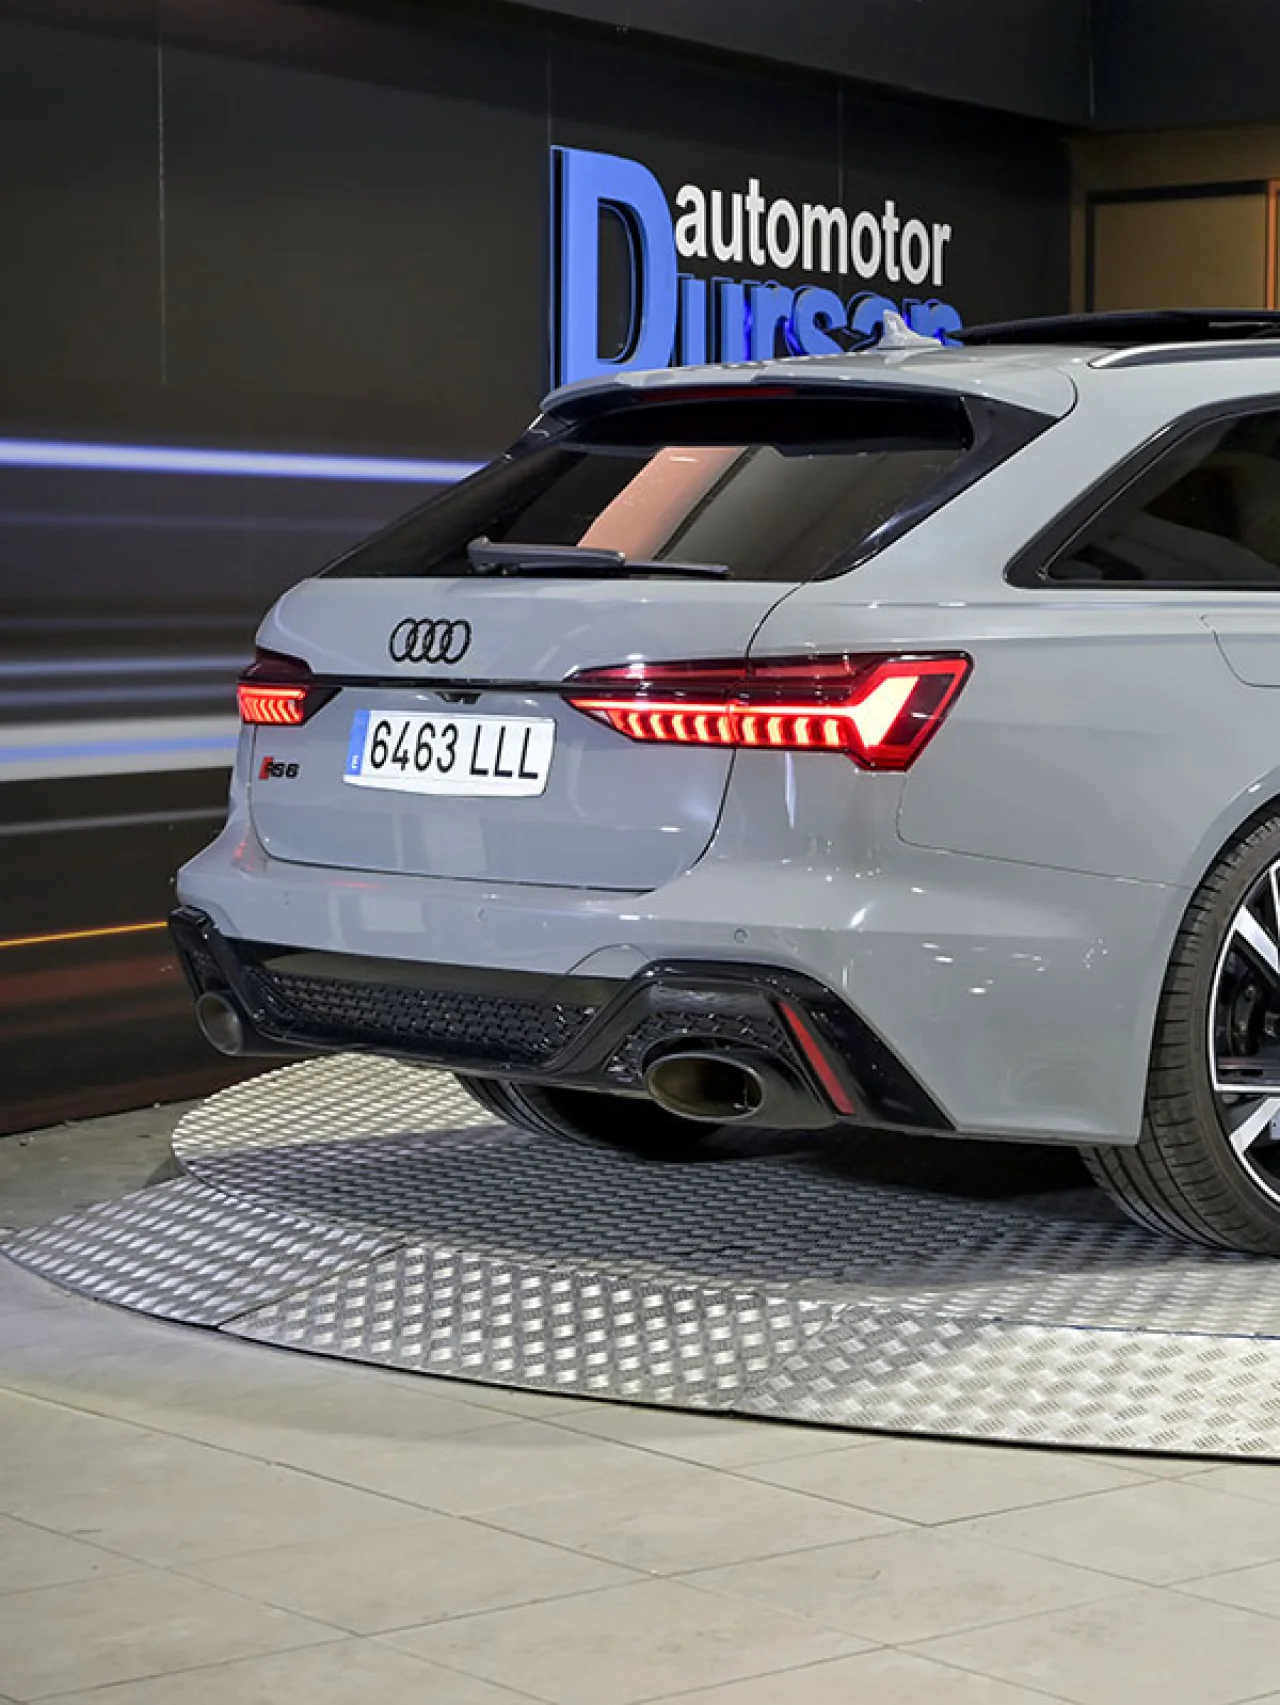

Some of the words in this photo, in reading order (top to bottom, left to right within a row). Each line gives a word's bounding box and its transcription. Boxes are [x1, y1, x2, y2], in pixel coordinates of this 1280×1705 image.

[675, 178, 952, 286] automotor
[370, 719, 459, 773] 6463
[469, 724, 539, 780] LLL
